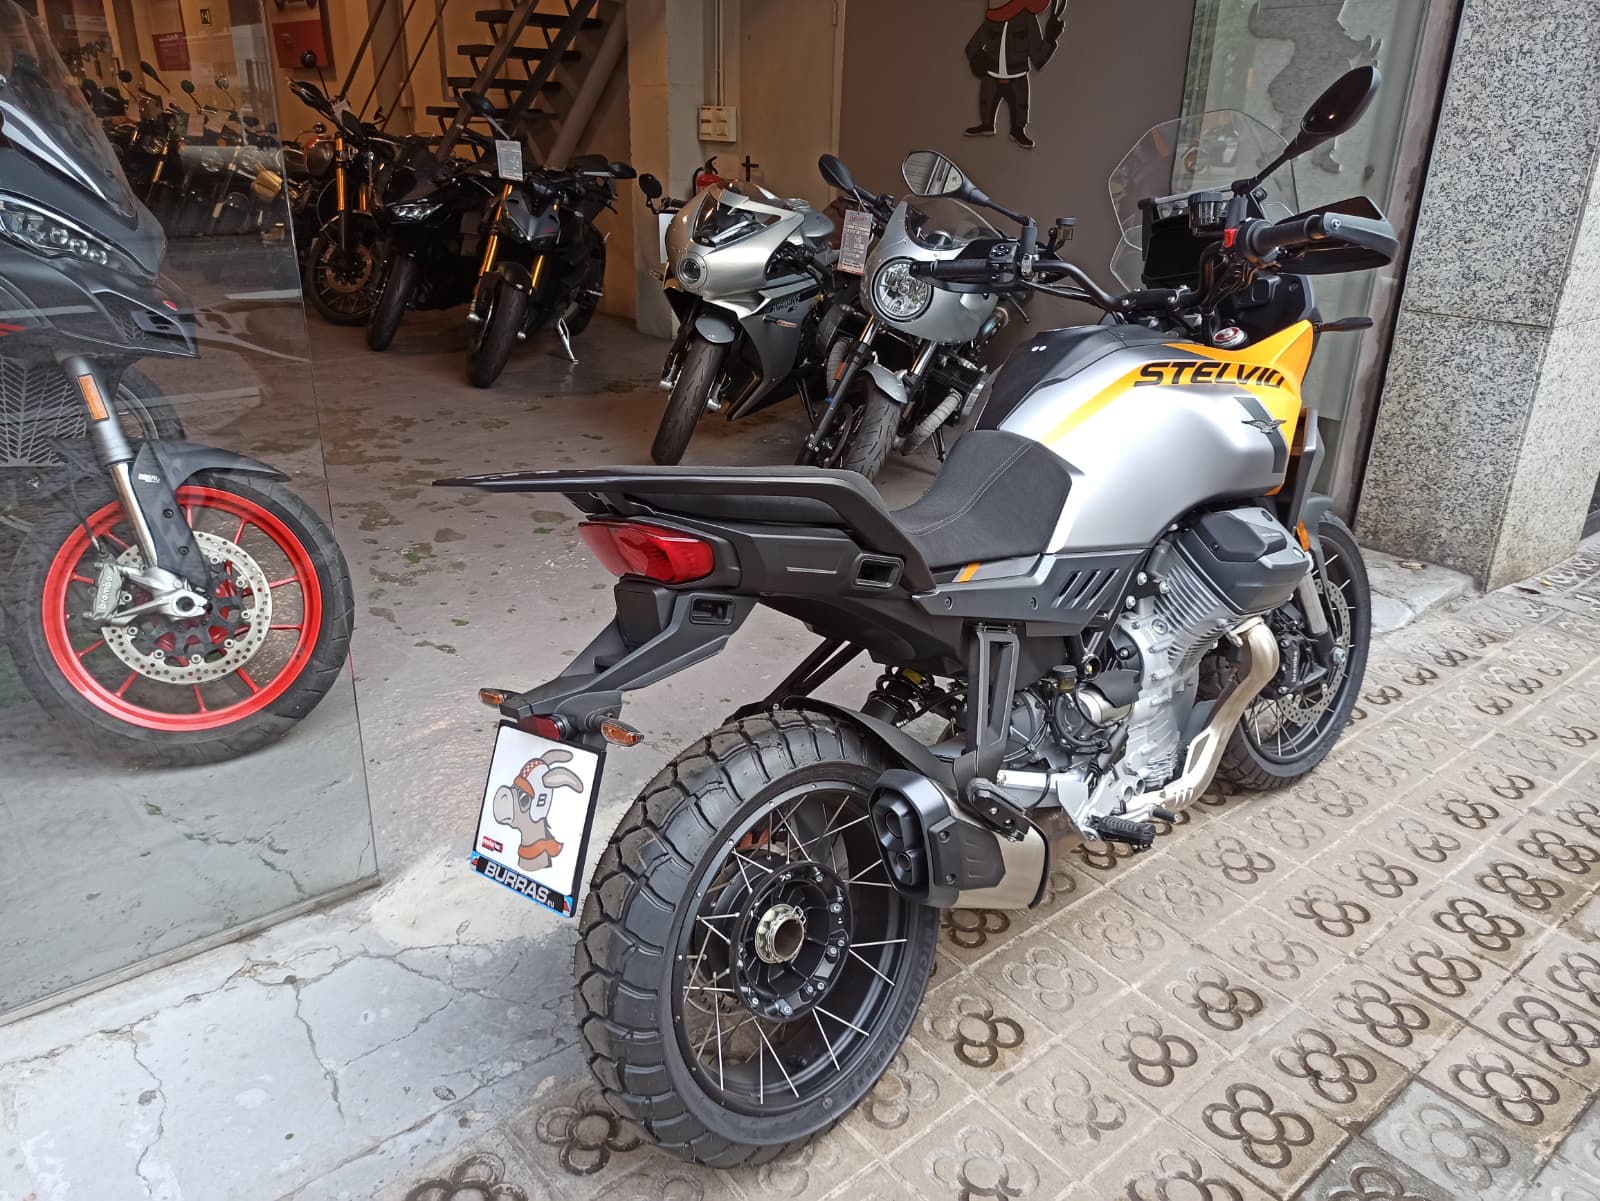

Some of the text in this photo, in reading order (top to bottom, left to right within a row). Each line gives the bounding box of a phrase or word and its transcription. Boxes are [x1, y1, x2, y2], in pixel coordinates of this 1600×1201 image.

[1133, 361, 1286, 389] STELVIO
[97, 575, 113, 610] brembo
[536, 793, 547, 808] B
[484, 861, 550, 904] BURRAS
